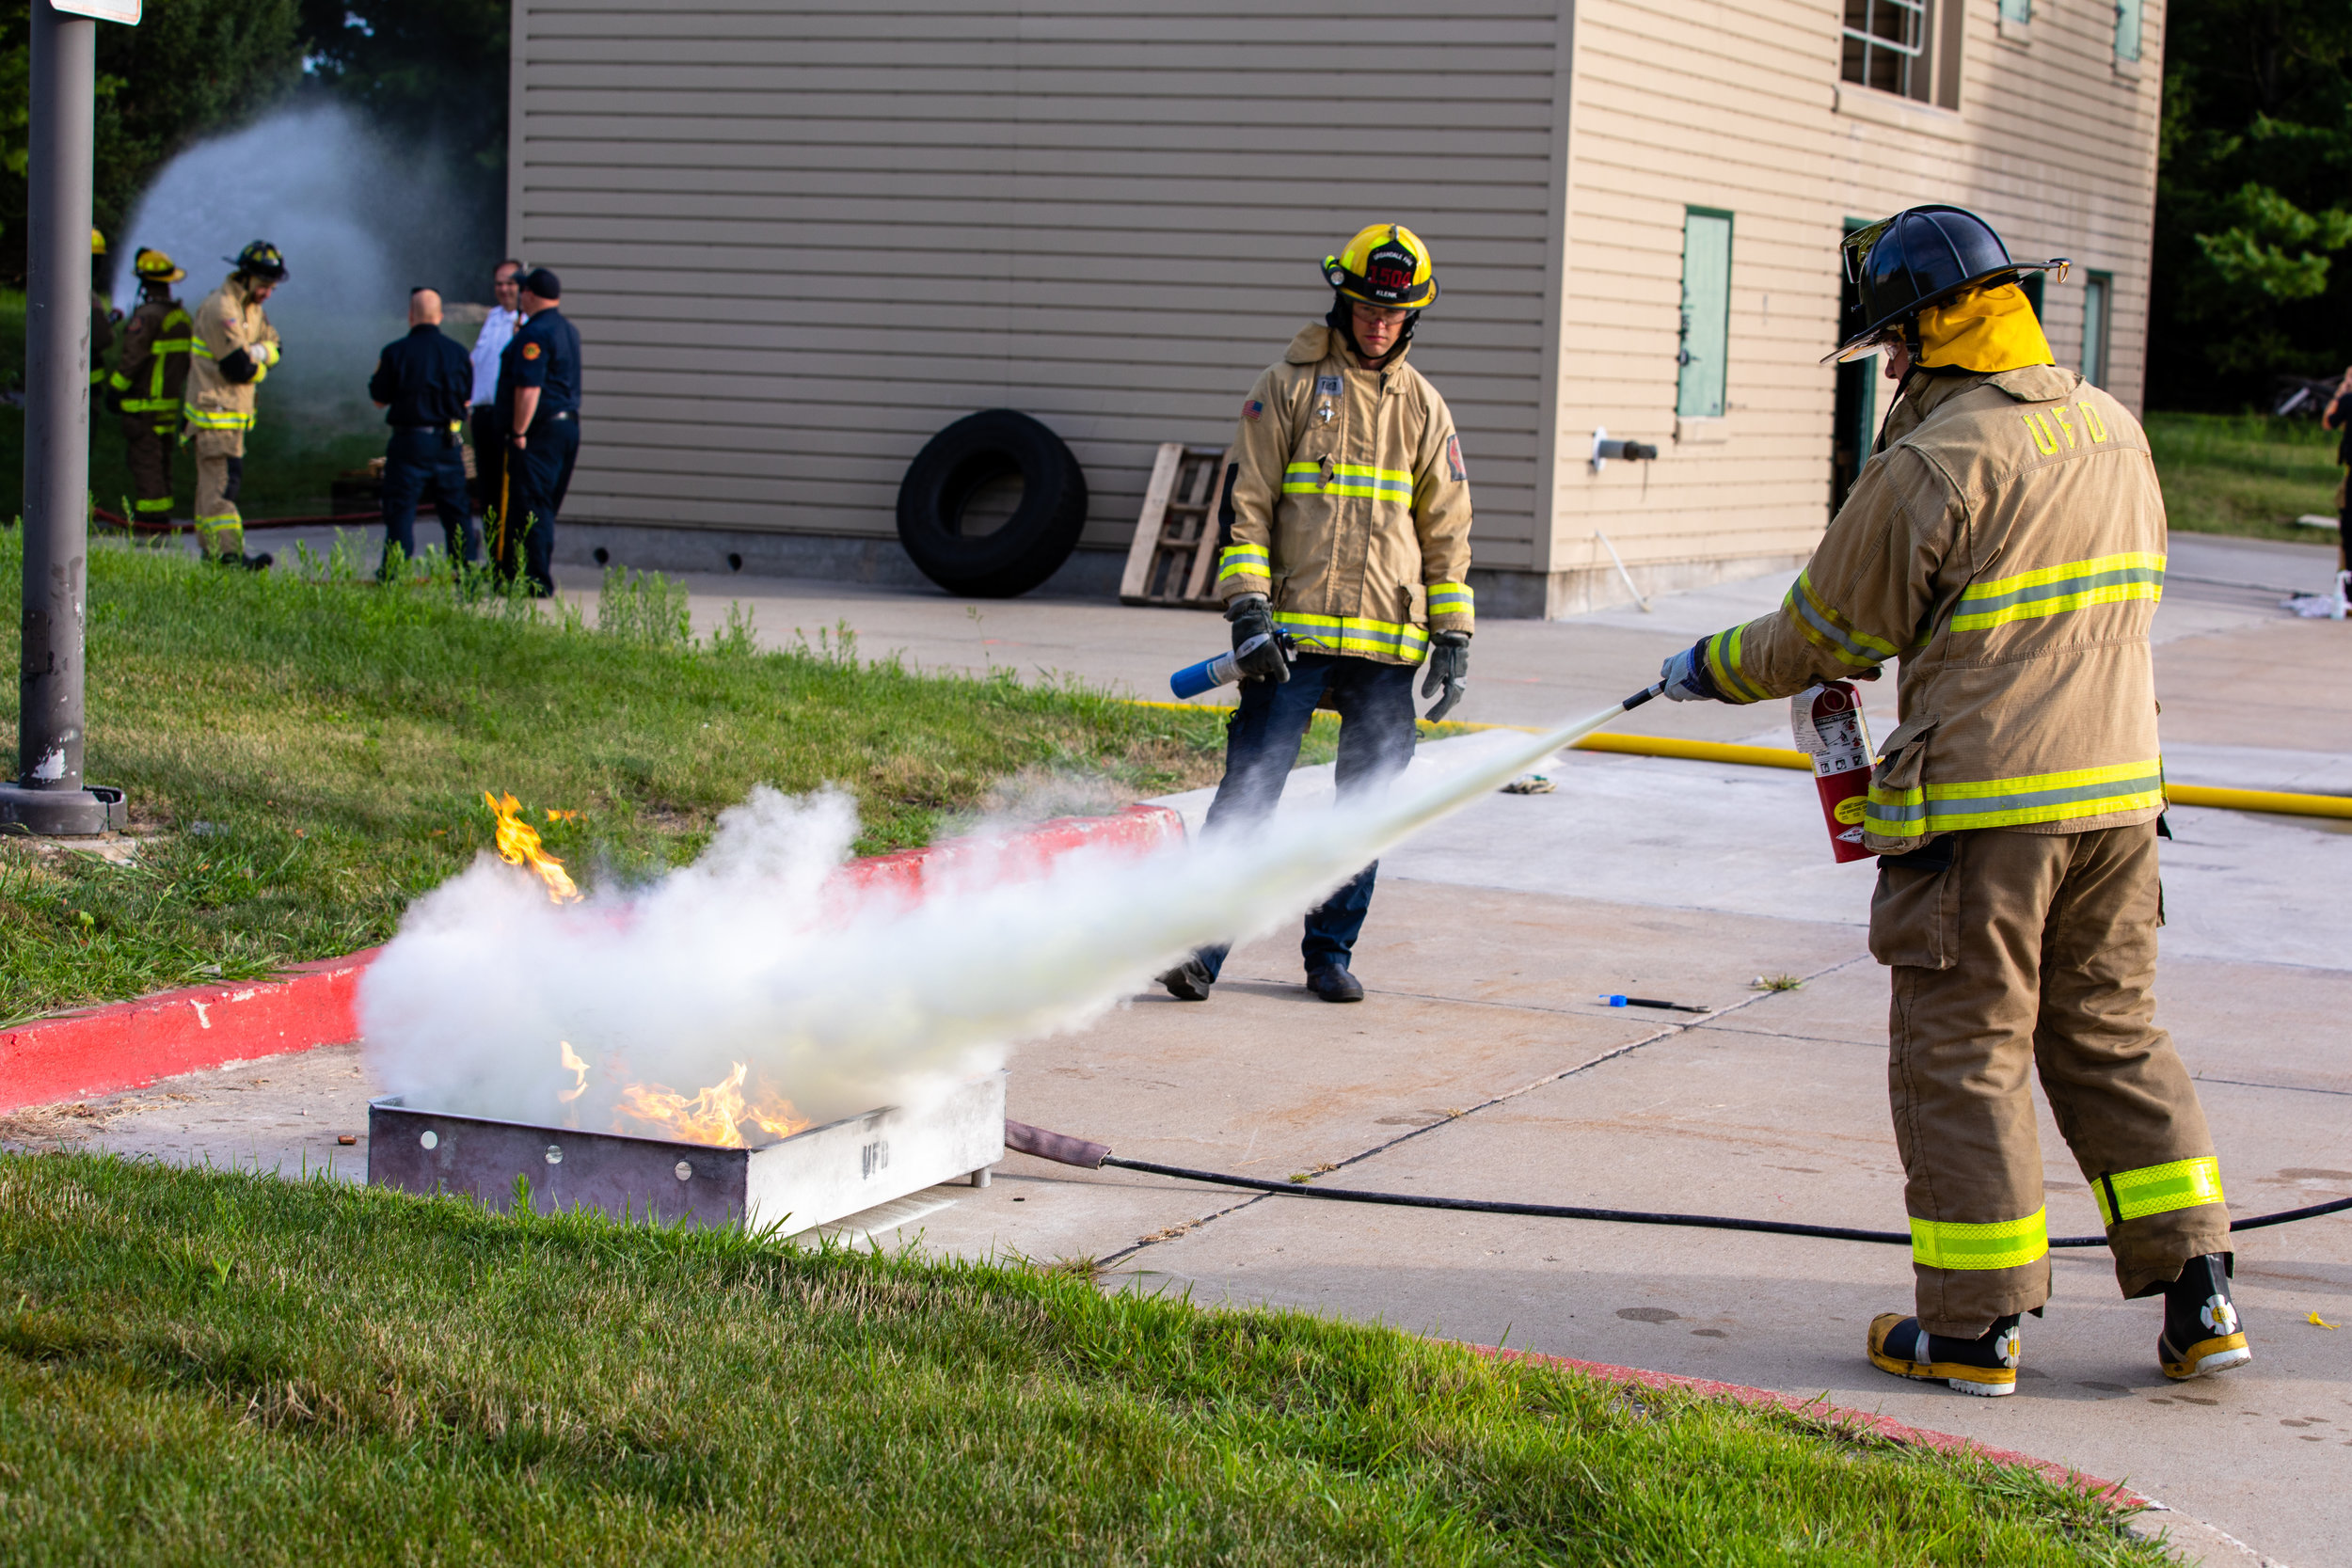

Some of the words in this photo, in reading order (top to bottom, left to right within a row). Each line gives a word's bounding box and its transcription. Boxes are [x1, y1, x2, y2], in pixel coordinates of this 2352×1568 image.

[1368, 265, 1411, 289] 1504
[2022, 401, 2107, 456] UFD
[1816, 713, 1851, 725] STRUCTIONS
[863, 1140, 889, 1180] UFD
